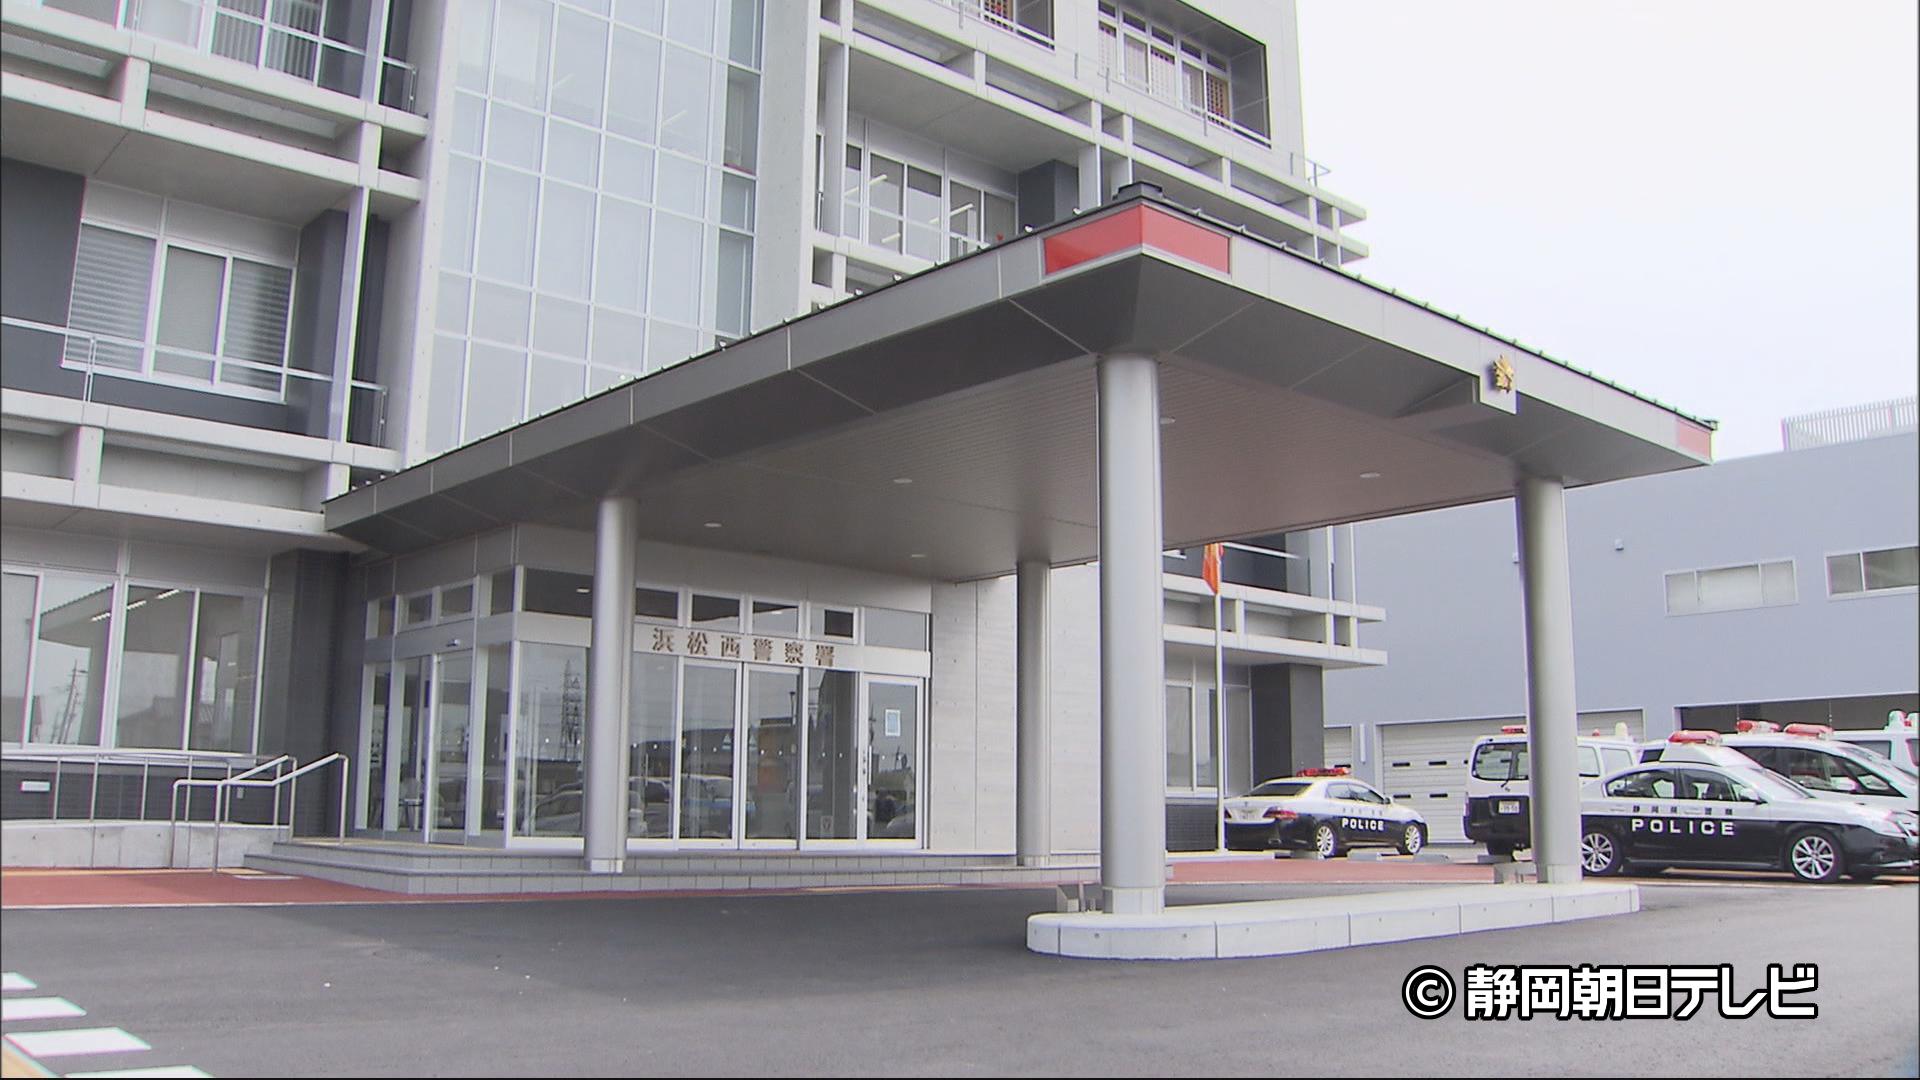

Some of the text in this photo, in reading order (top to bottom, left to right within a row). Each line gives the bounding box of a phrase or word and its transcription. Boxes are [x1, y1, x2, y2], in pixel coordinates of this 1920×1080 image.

[652, 627, 835, 666] 浜松西警察署
[1341, 817, 1385, 831] POLICE
[1631, 818, 1735, 836] POLICE
